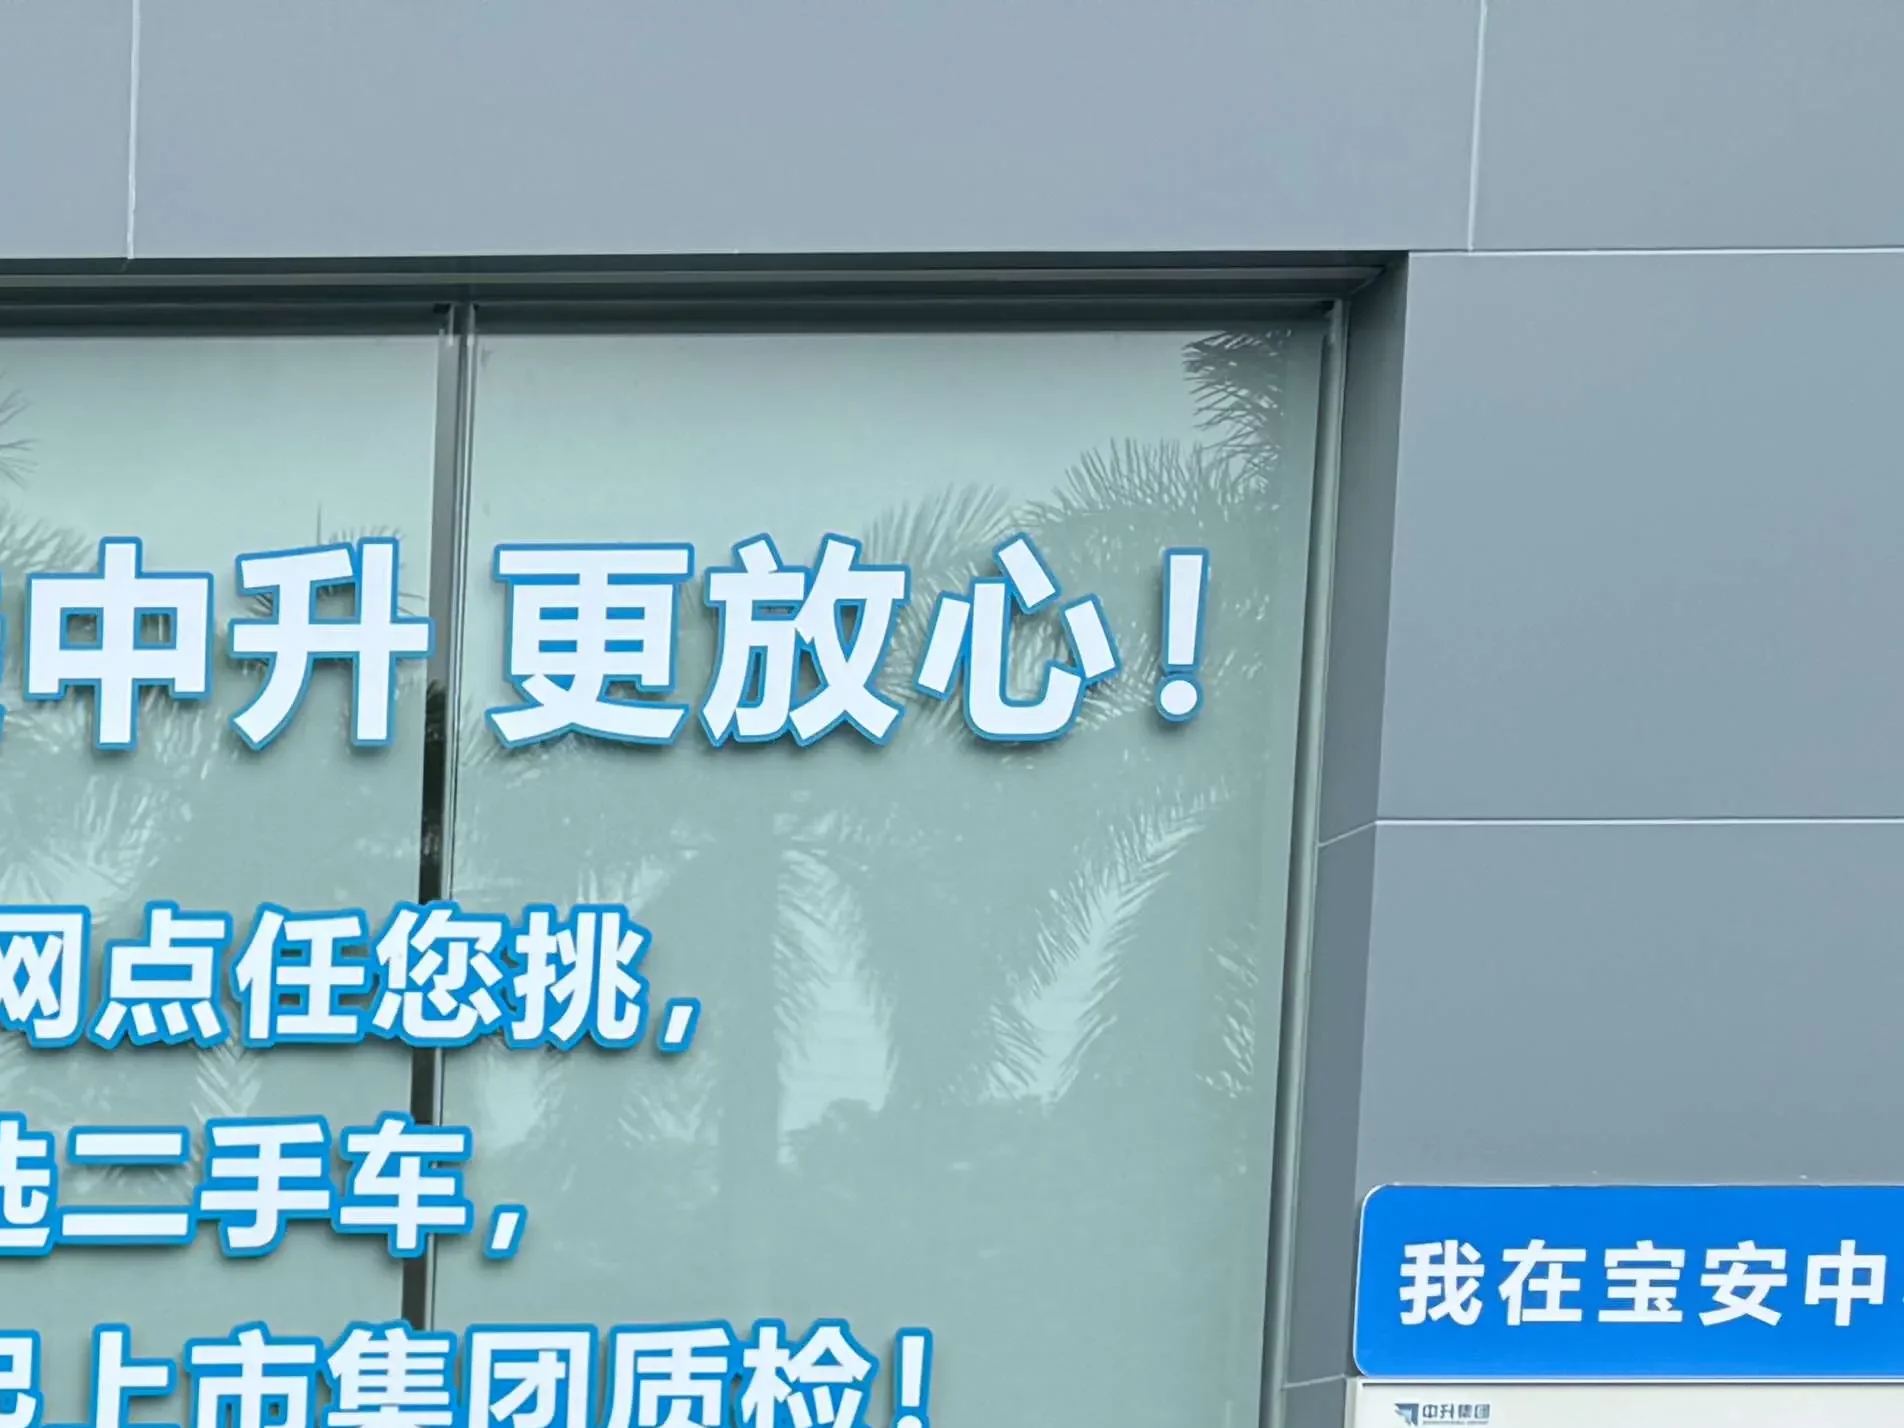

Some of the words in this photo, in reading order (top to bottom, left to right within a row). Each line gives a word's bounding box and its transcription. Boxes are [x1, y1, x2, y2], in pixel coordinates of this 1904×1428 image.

[488, 533, 1210, 748] 更放心!
[1422, 1403, 1491, 1419] 中升集团
